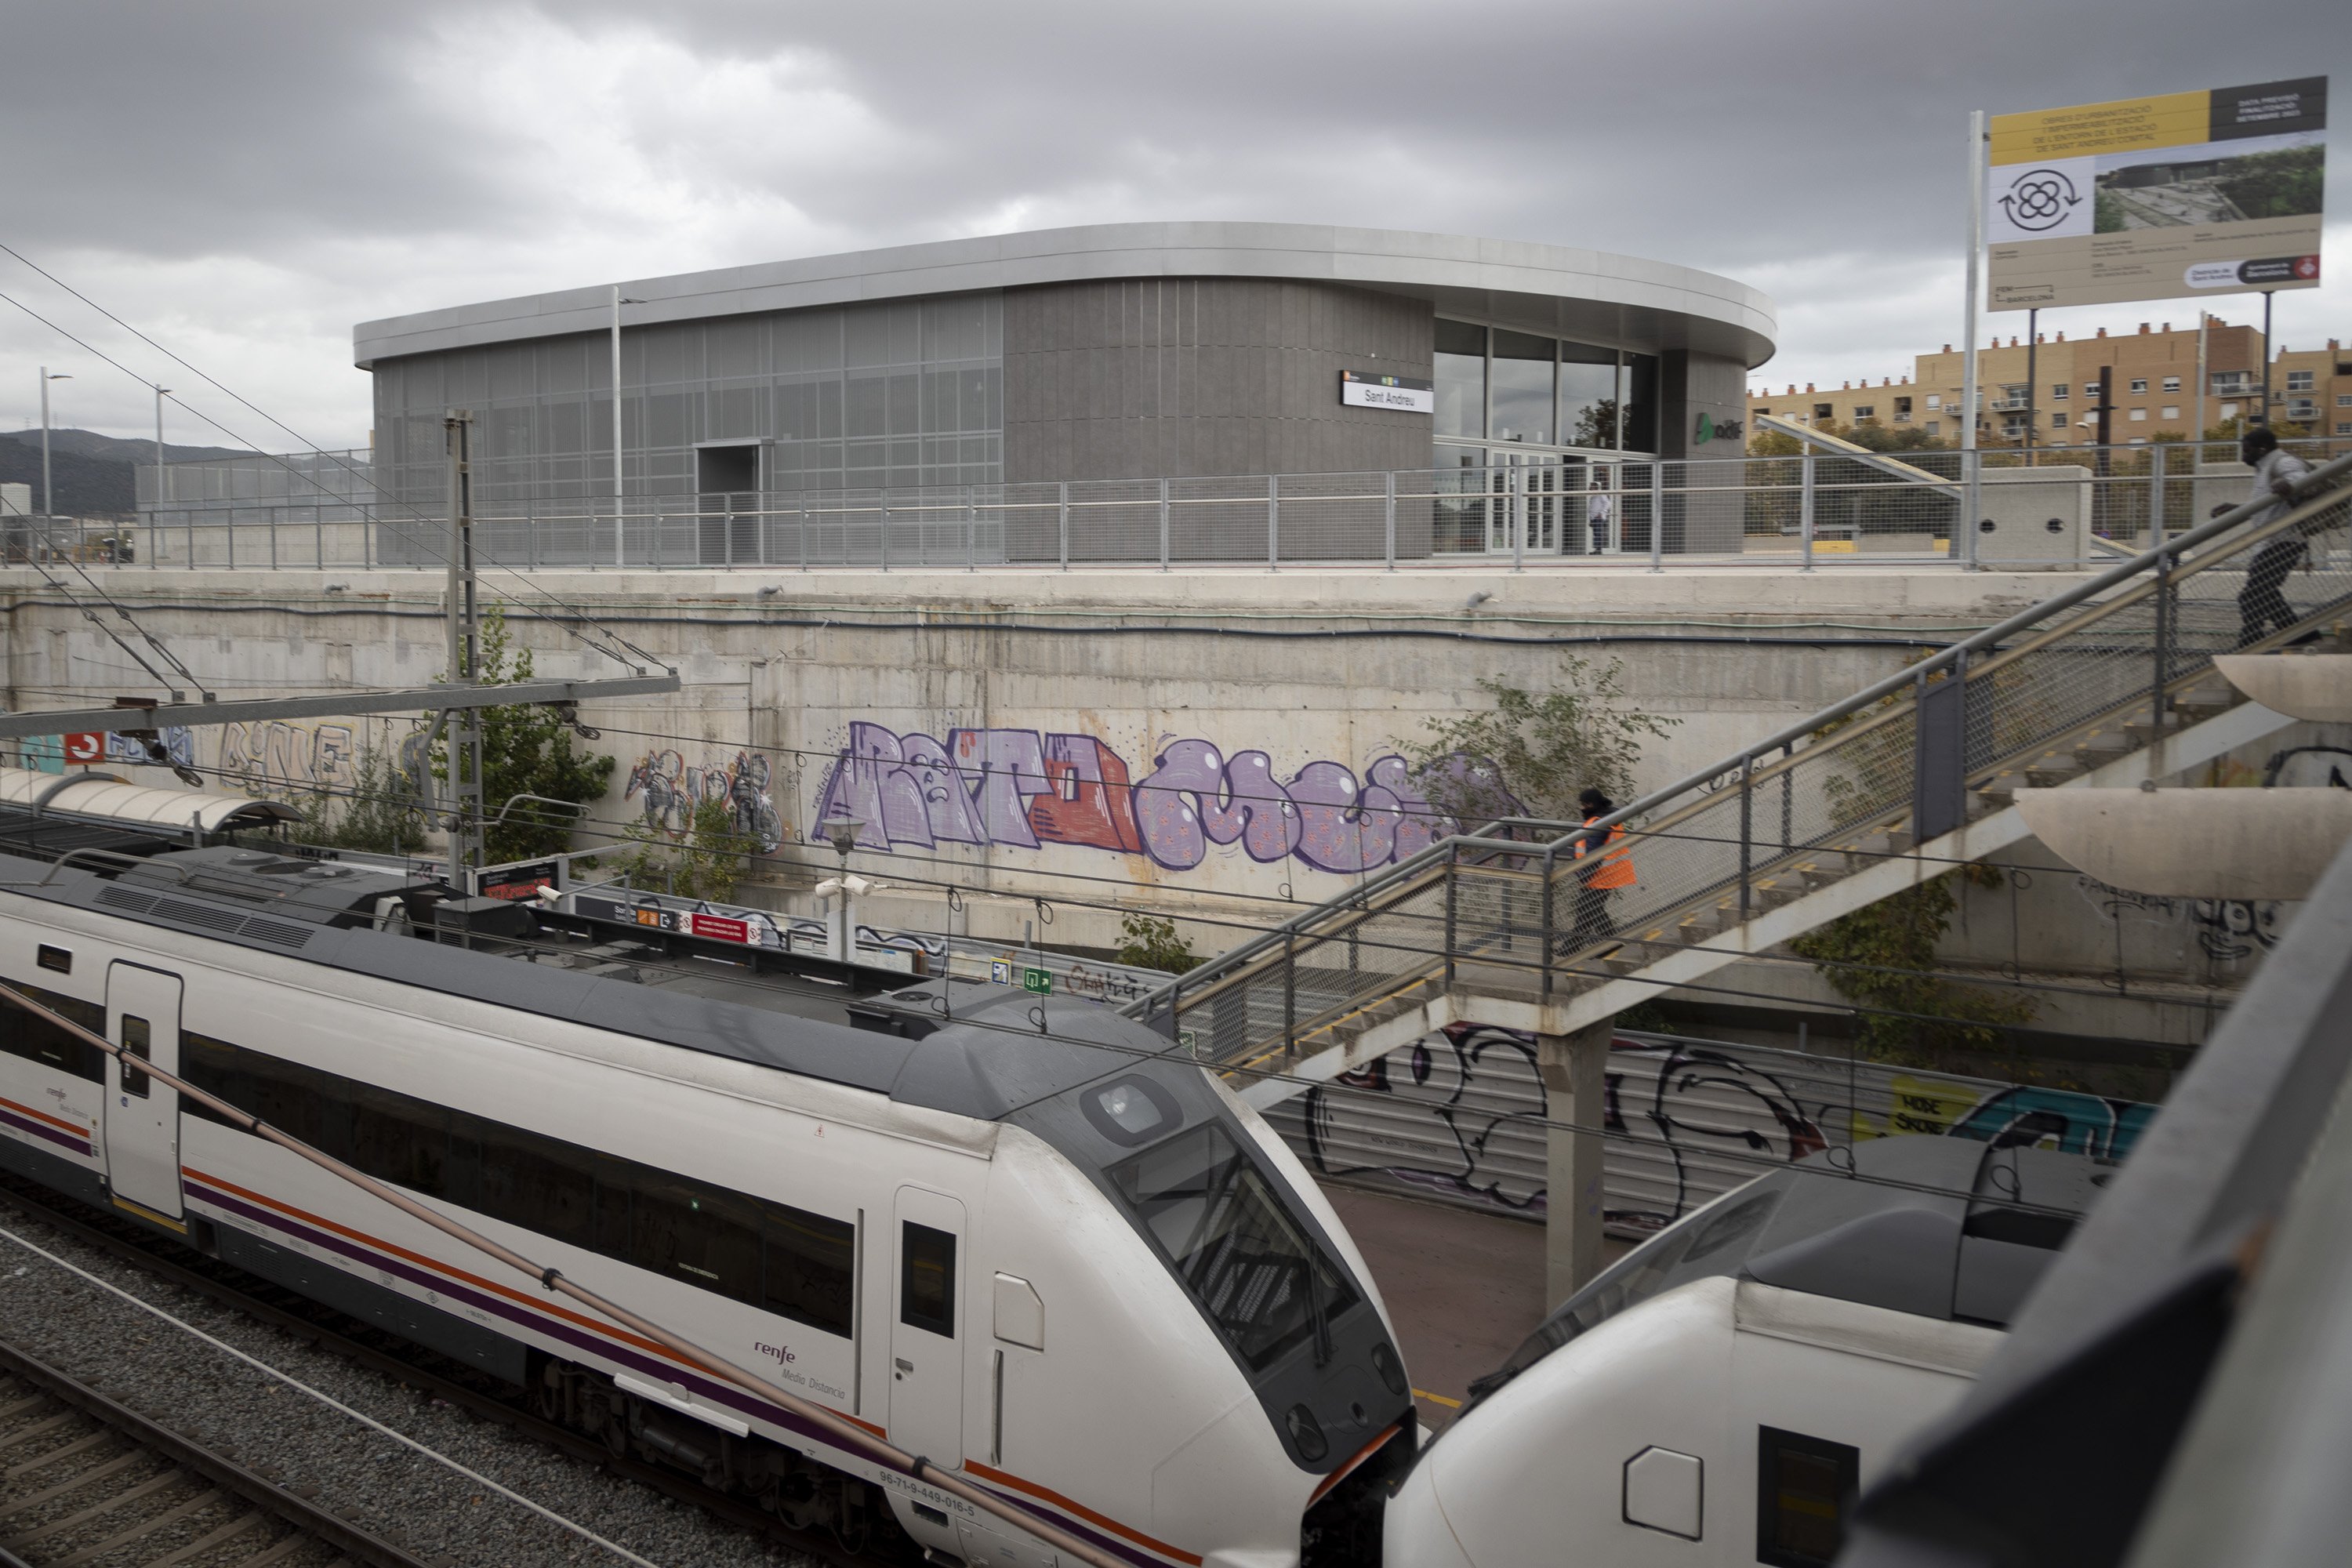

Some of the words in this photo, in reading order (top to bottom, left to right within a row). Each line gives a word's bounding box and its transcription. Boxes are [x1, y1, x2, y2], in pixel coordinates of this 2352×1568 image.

[2006, 294, 2055, 303] BARCELONA
[1365, 389, 1385, 403] Sant
[1385, 392, 1415, 407] Andreu
[46, 1088, 67, 1102] renfe
[754, 1341, 796, 1365] renfe
[782, 1368, 806, 1385] Media
[809, 1377, 845, 1399] Distancia
[880, 1471, 975, 1517] 96-71-9-449-016-5
